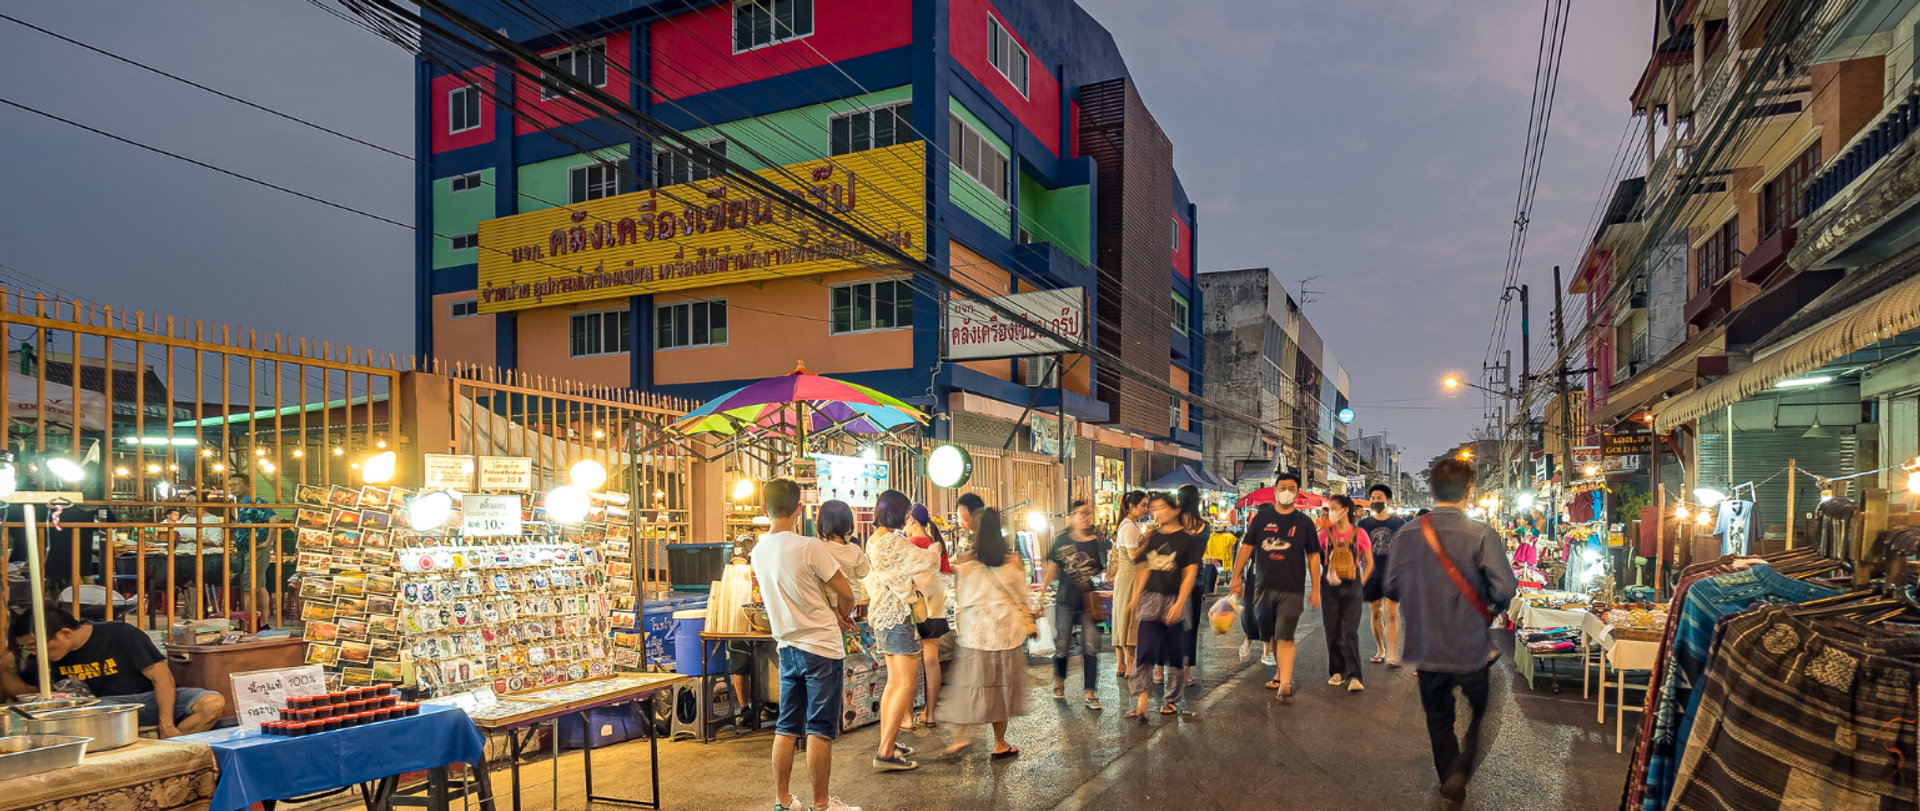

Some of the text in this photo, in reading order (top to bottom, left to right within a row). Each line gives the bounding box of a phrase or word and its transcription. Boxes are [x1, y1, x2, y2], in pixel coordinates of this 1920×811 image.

[1605, 445, 1631, 455] GOLD
[1631, 445, 1639, 454] &
[287, 674, 317, 687] 100%
